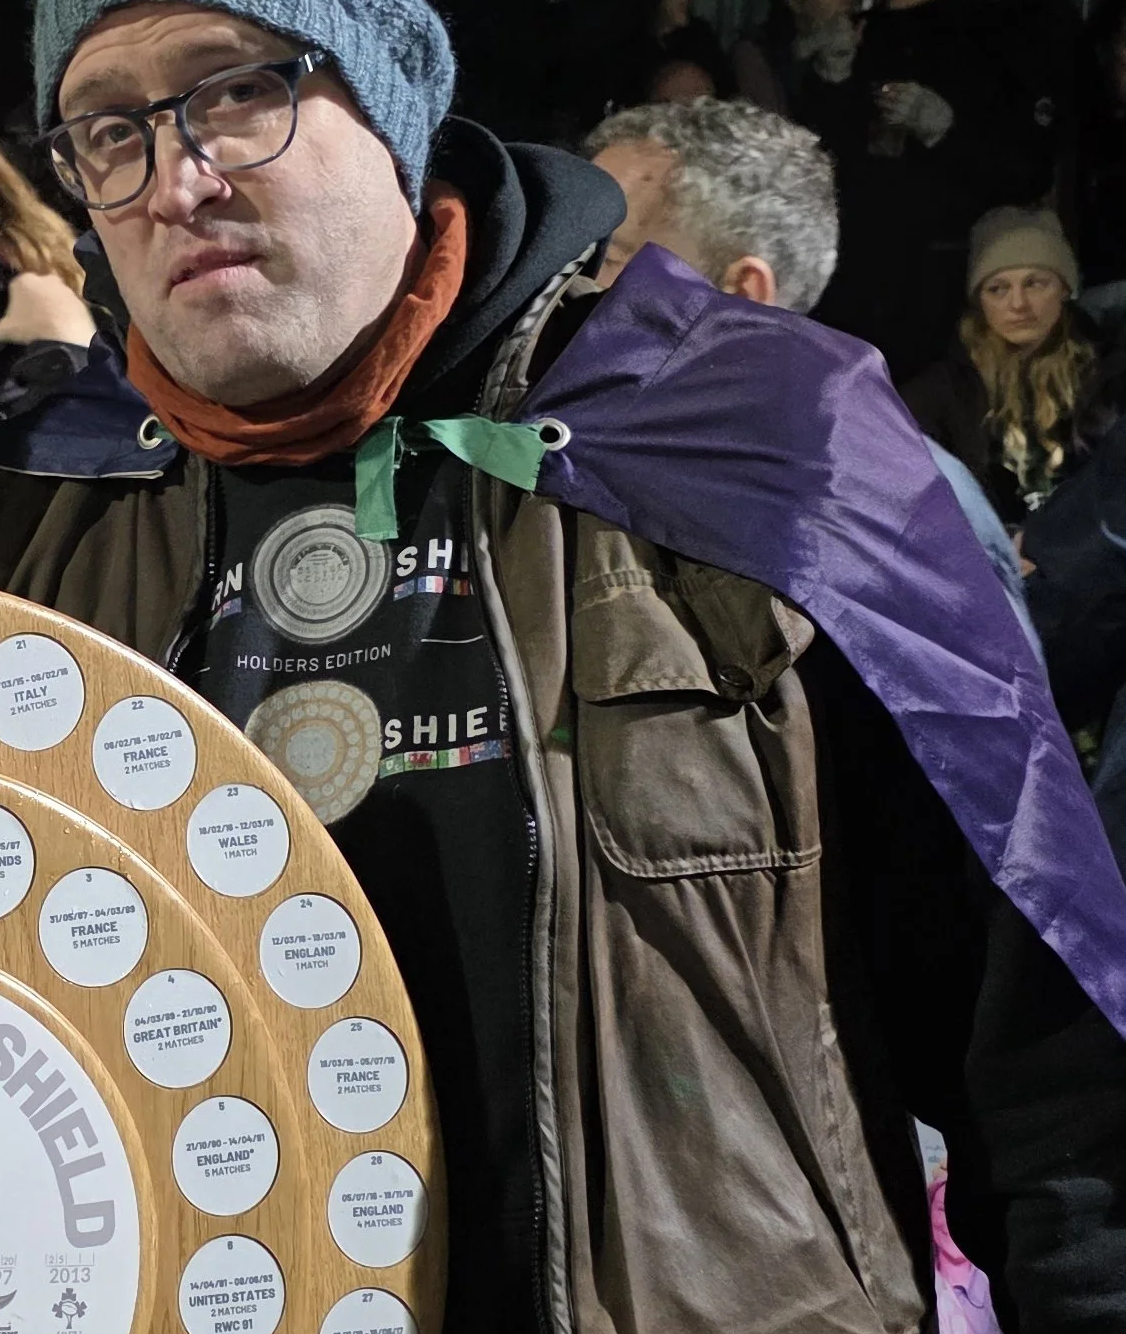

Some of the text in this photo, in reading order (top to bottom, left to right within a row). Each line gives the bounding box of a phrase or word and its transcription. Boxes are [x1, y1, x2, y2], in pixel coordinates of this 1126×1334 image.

[16, 640, 26, 649] 21
[236, 643, 391, 673] HOLDERS EDITION
[14, 686, 47, 702] ITALY
[132, 701, 144, 710] 22
[123, 745, 168, 762] FRANCE
[227, 789, 238, 797] 23
[218, 835, 258, 848] WALES
[86, 874, 92, 882] 3
[71, 921, 118, 937] FRANCE
[285, 945, 336, 960] ENGLAND
[351, 1023, 362, 1031] 25
[134, 1027, 170, 1043] GREAT
[337, 1071, 380, 1083] FRANCE
[205, 1164, 251, 1177] 5 MATCHES
[353, 1204, 403, 1217] ENGLAND
[49, 1267, 91, 1284] 2013
[189, 1288, 275, 1307] UNITED STATES
[362, 1293, 373, 1303] 27
[215, 1319, 253, 1333] RWC 91
